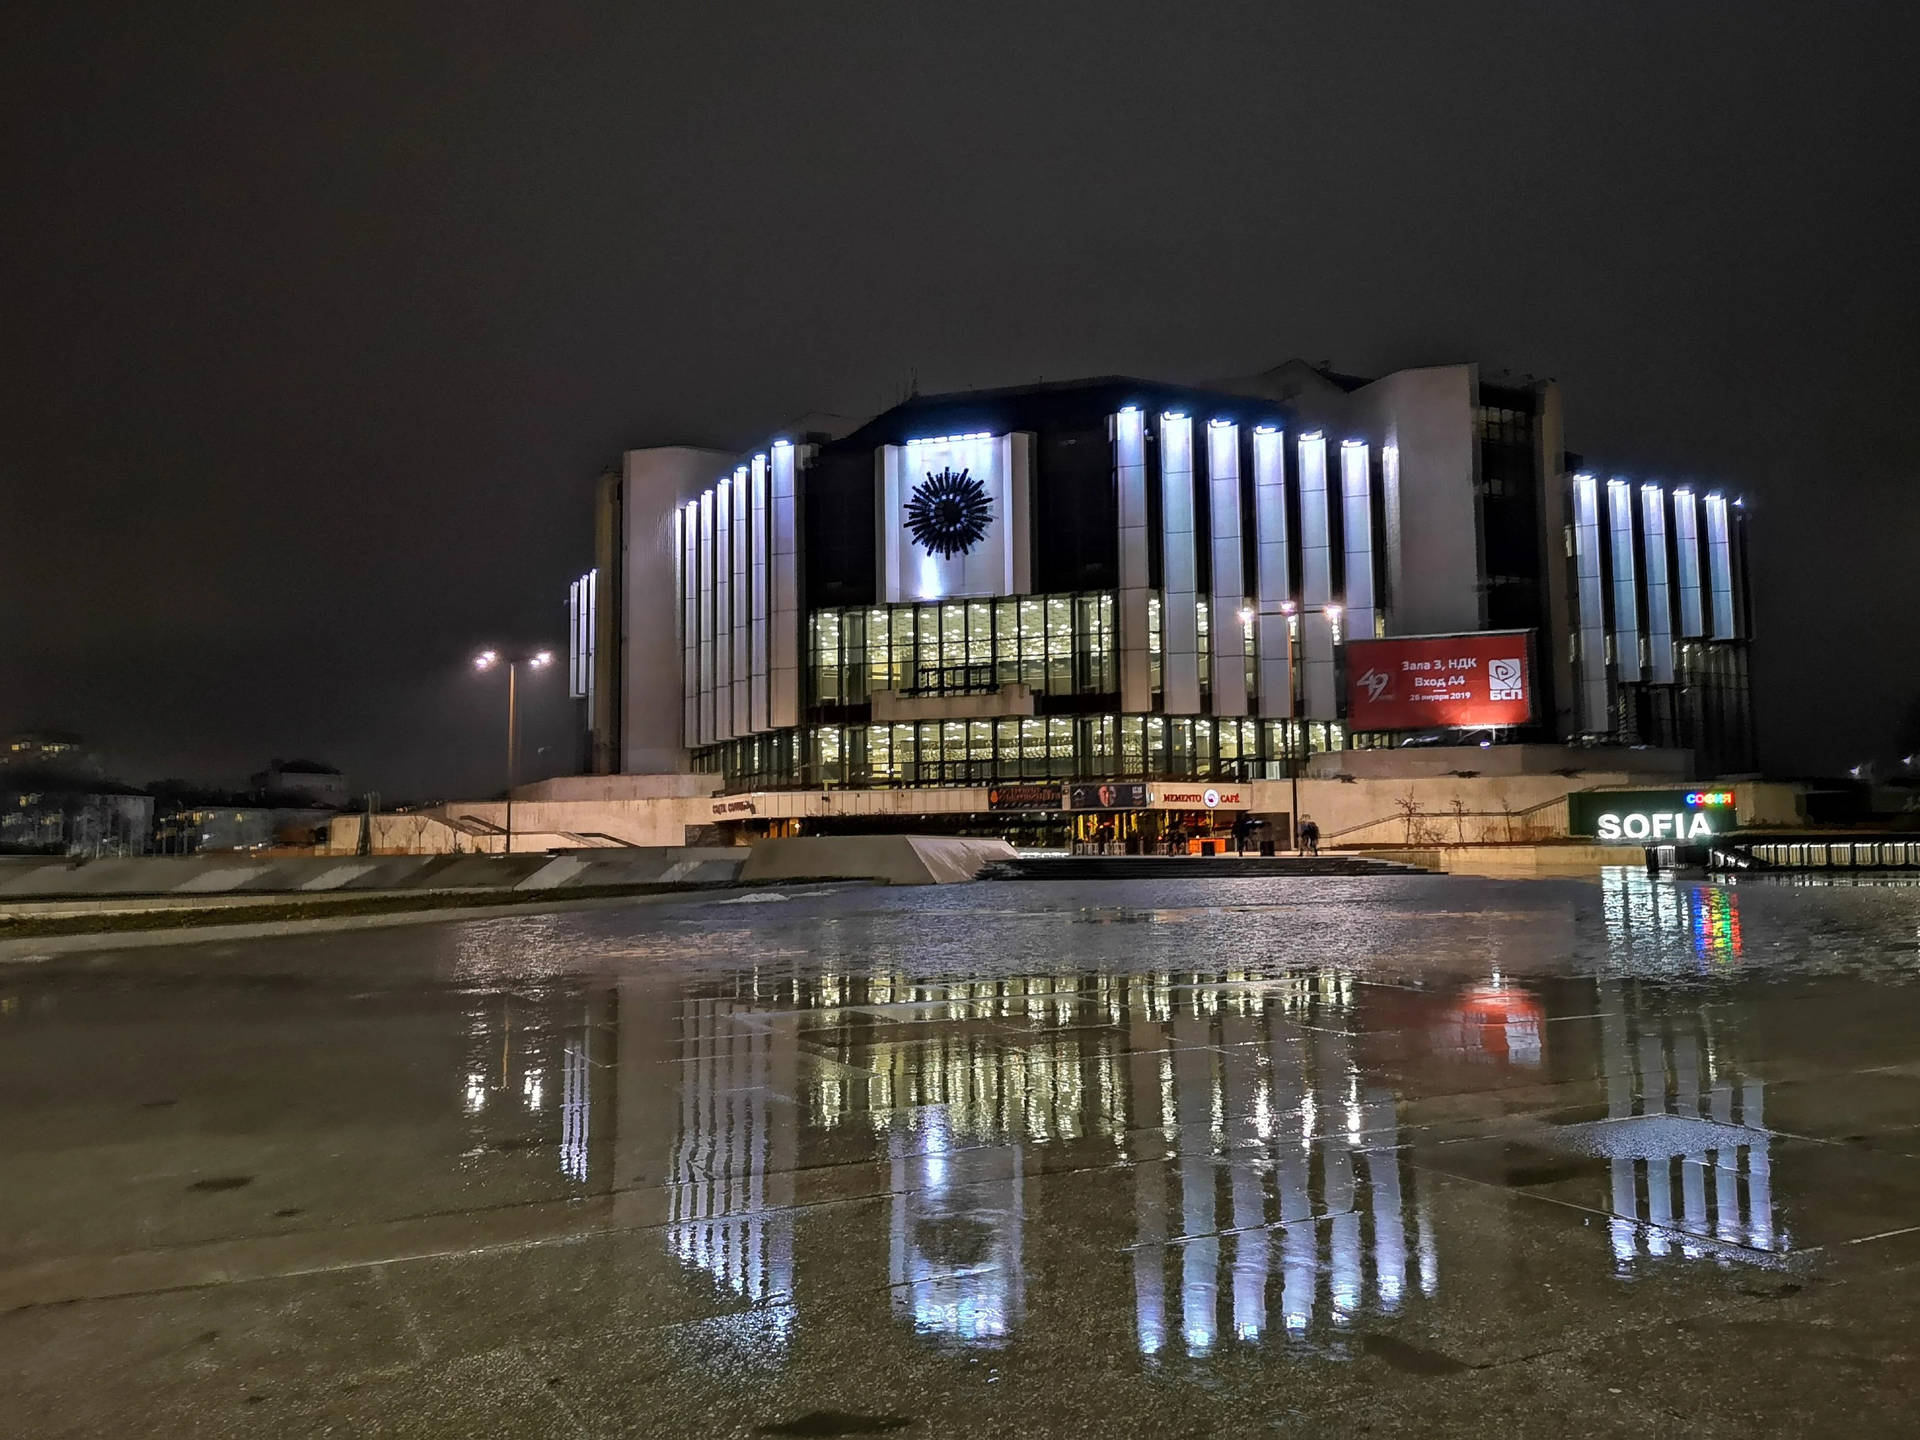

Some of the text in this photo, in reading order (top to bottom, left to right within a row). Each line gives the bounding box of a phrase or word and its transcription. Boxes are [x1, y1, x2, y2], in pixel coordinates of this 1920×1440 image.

[1402, 661, 1431, 671] Зала
[1448, 658, 1477, 670] НДК
[1415, 677, 1446, 688] Вход
[1450, 692, 1471, 700] 2019
[1489, 689, 1523, 701] БСП
[1163, 793, 1202, 803] MEMENTO
[1686, 793, 1733, 804] СОФИЯ
[1597, 812, 1712, 840] SOFIA
